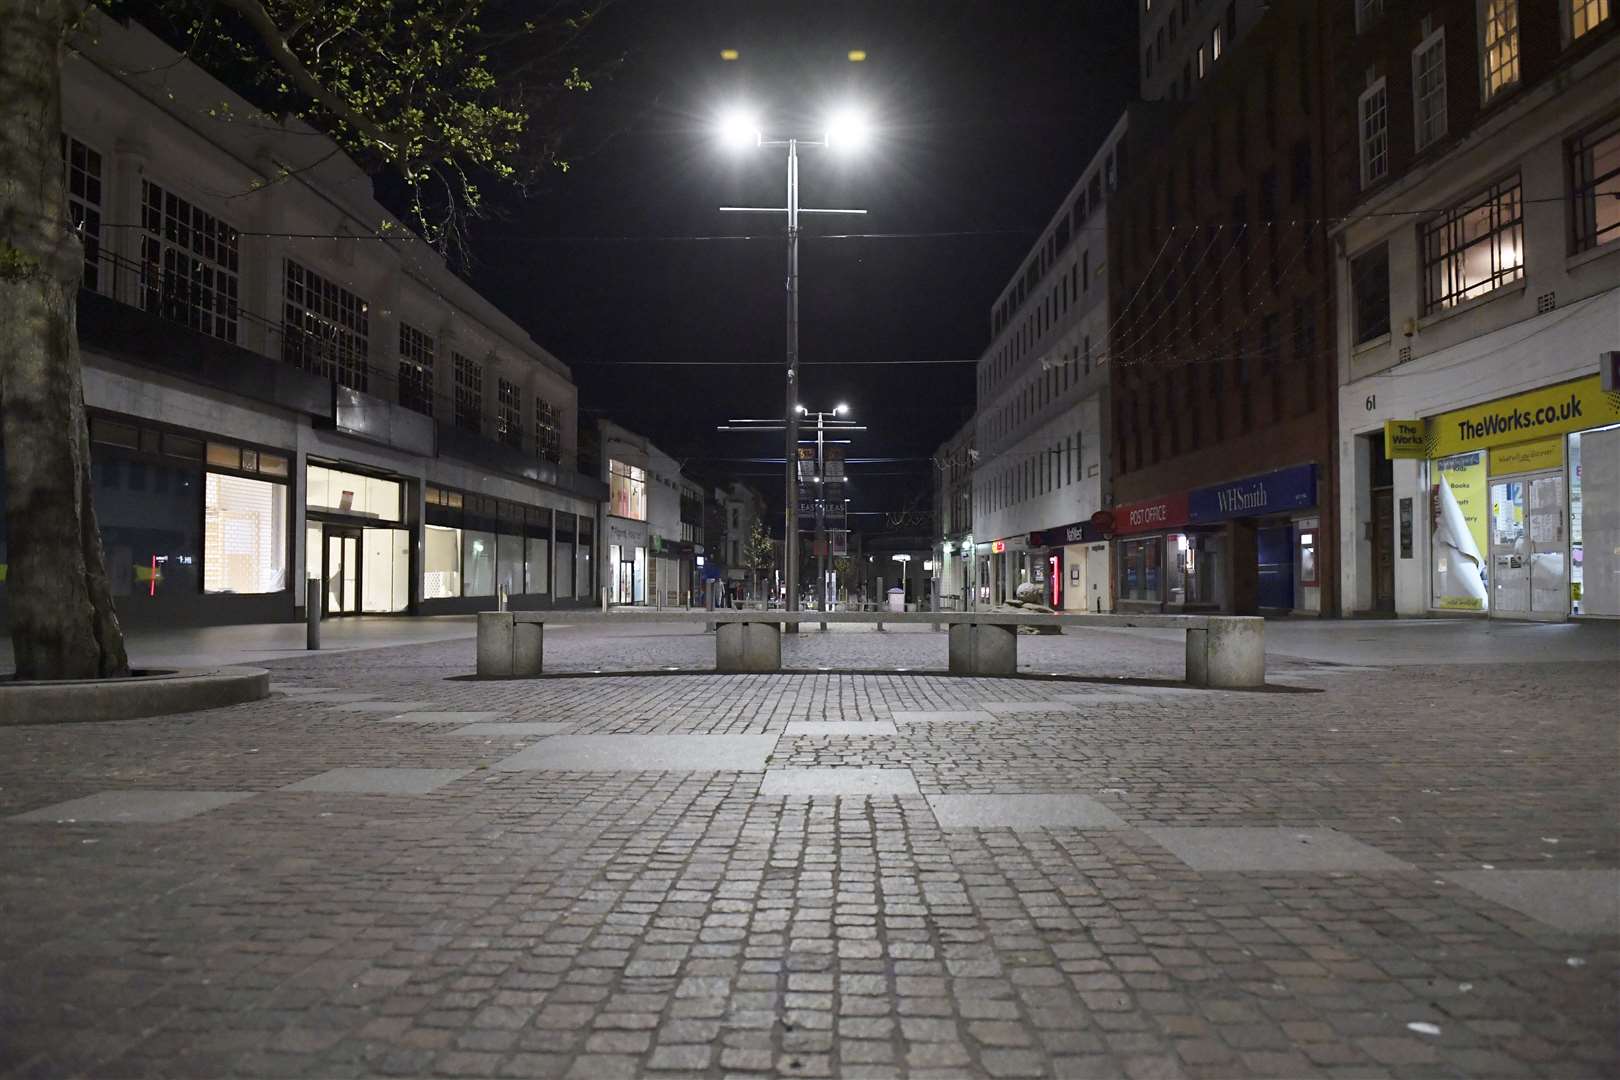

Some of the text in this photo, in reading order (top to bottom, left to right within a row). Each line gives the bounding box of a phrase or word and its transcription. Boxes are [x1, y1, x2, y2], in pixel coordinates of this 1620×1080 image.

[1366, 394, 1376, 411] 61
[1458, 394, 1583, 440] TheWorks.co.uk
[1398, 424, 1416, 434] The
[1393, 435, 1423, 445] Works
[1217, 481, 1268, 513] WHSmith
[1129, 504, 1168, 526] POST OFFICE
